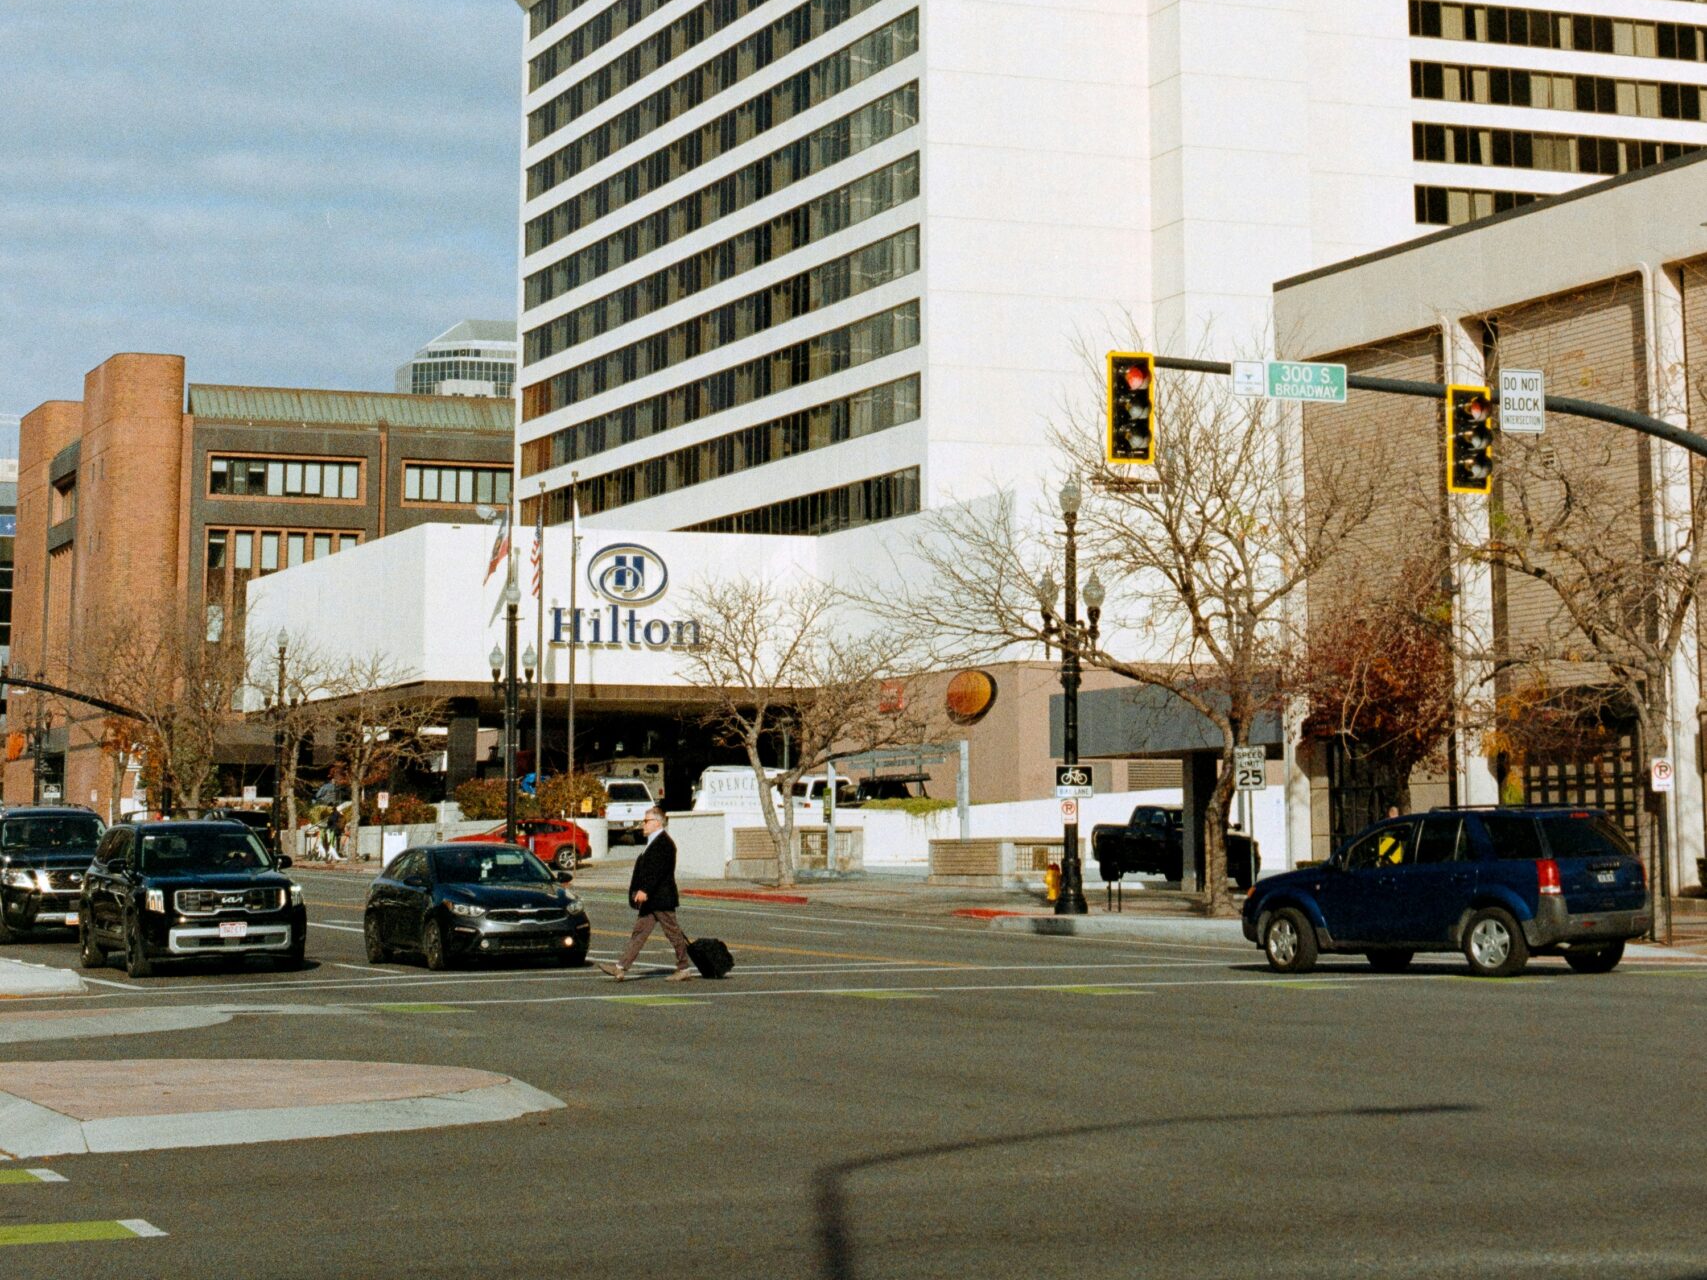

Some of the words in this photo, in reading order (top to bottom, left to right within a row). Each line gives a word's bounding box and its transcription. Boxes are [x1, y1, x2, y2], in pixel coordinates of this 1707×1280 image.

[1281, 365, 1312, 383] 300
[1275, 383, 1338, 399] BROADWAY
[1504, 377, 1517, 391] DO
[1521, 377, 1540, 392] NOT
[1504, 397, 1540, 411] BLOCK
[1504, 414, 1541, 426] INTERSECTION
[549, 604, 705, 651] Hilton
[1236, 751, 1263, 759] SPEED
[1239, 760, 1260, 768] LIMIT
[709, 777, 757, 794] SPENCE
[1238, 770, 1263, 786] 25
[1074, 788, 1089, 796] LANE
